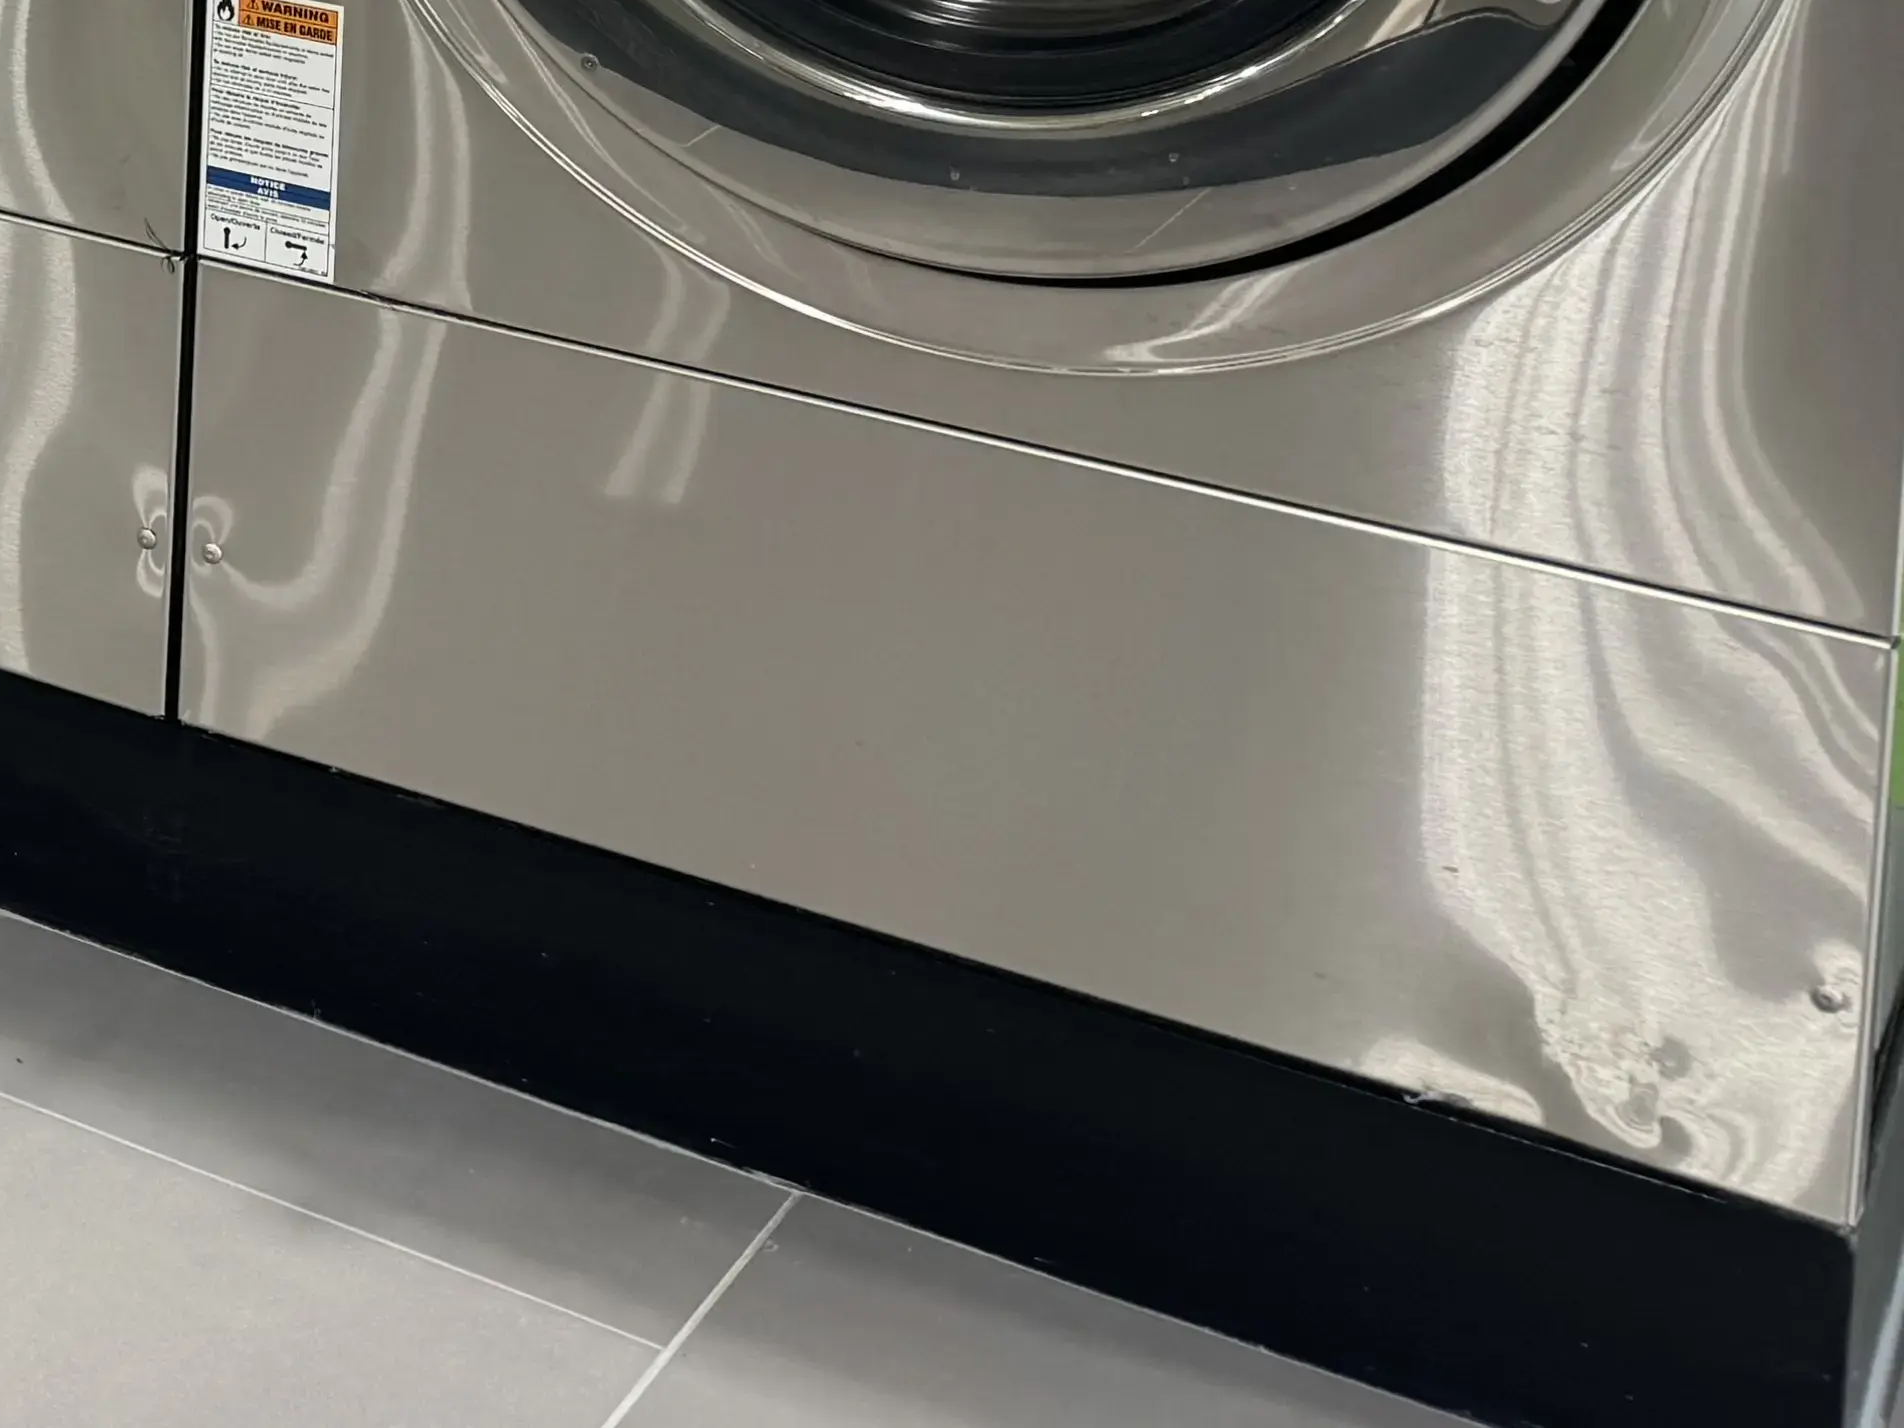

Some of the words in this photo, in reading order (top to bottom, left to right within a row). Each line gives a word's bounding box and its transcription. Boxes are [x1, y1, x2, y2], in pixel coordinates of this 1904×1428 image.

[261, 0, 330, 24] WARNING
[256, 16, 281, 31] MISE
[284, 22, 297, 35] EN
[299, 25, 333, 42] GARDE
[250, 176, 286, 191] NOTICE
